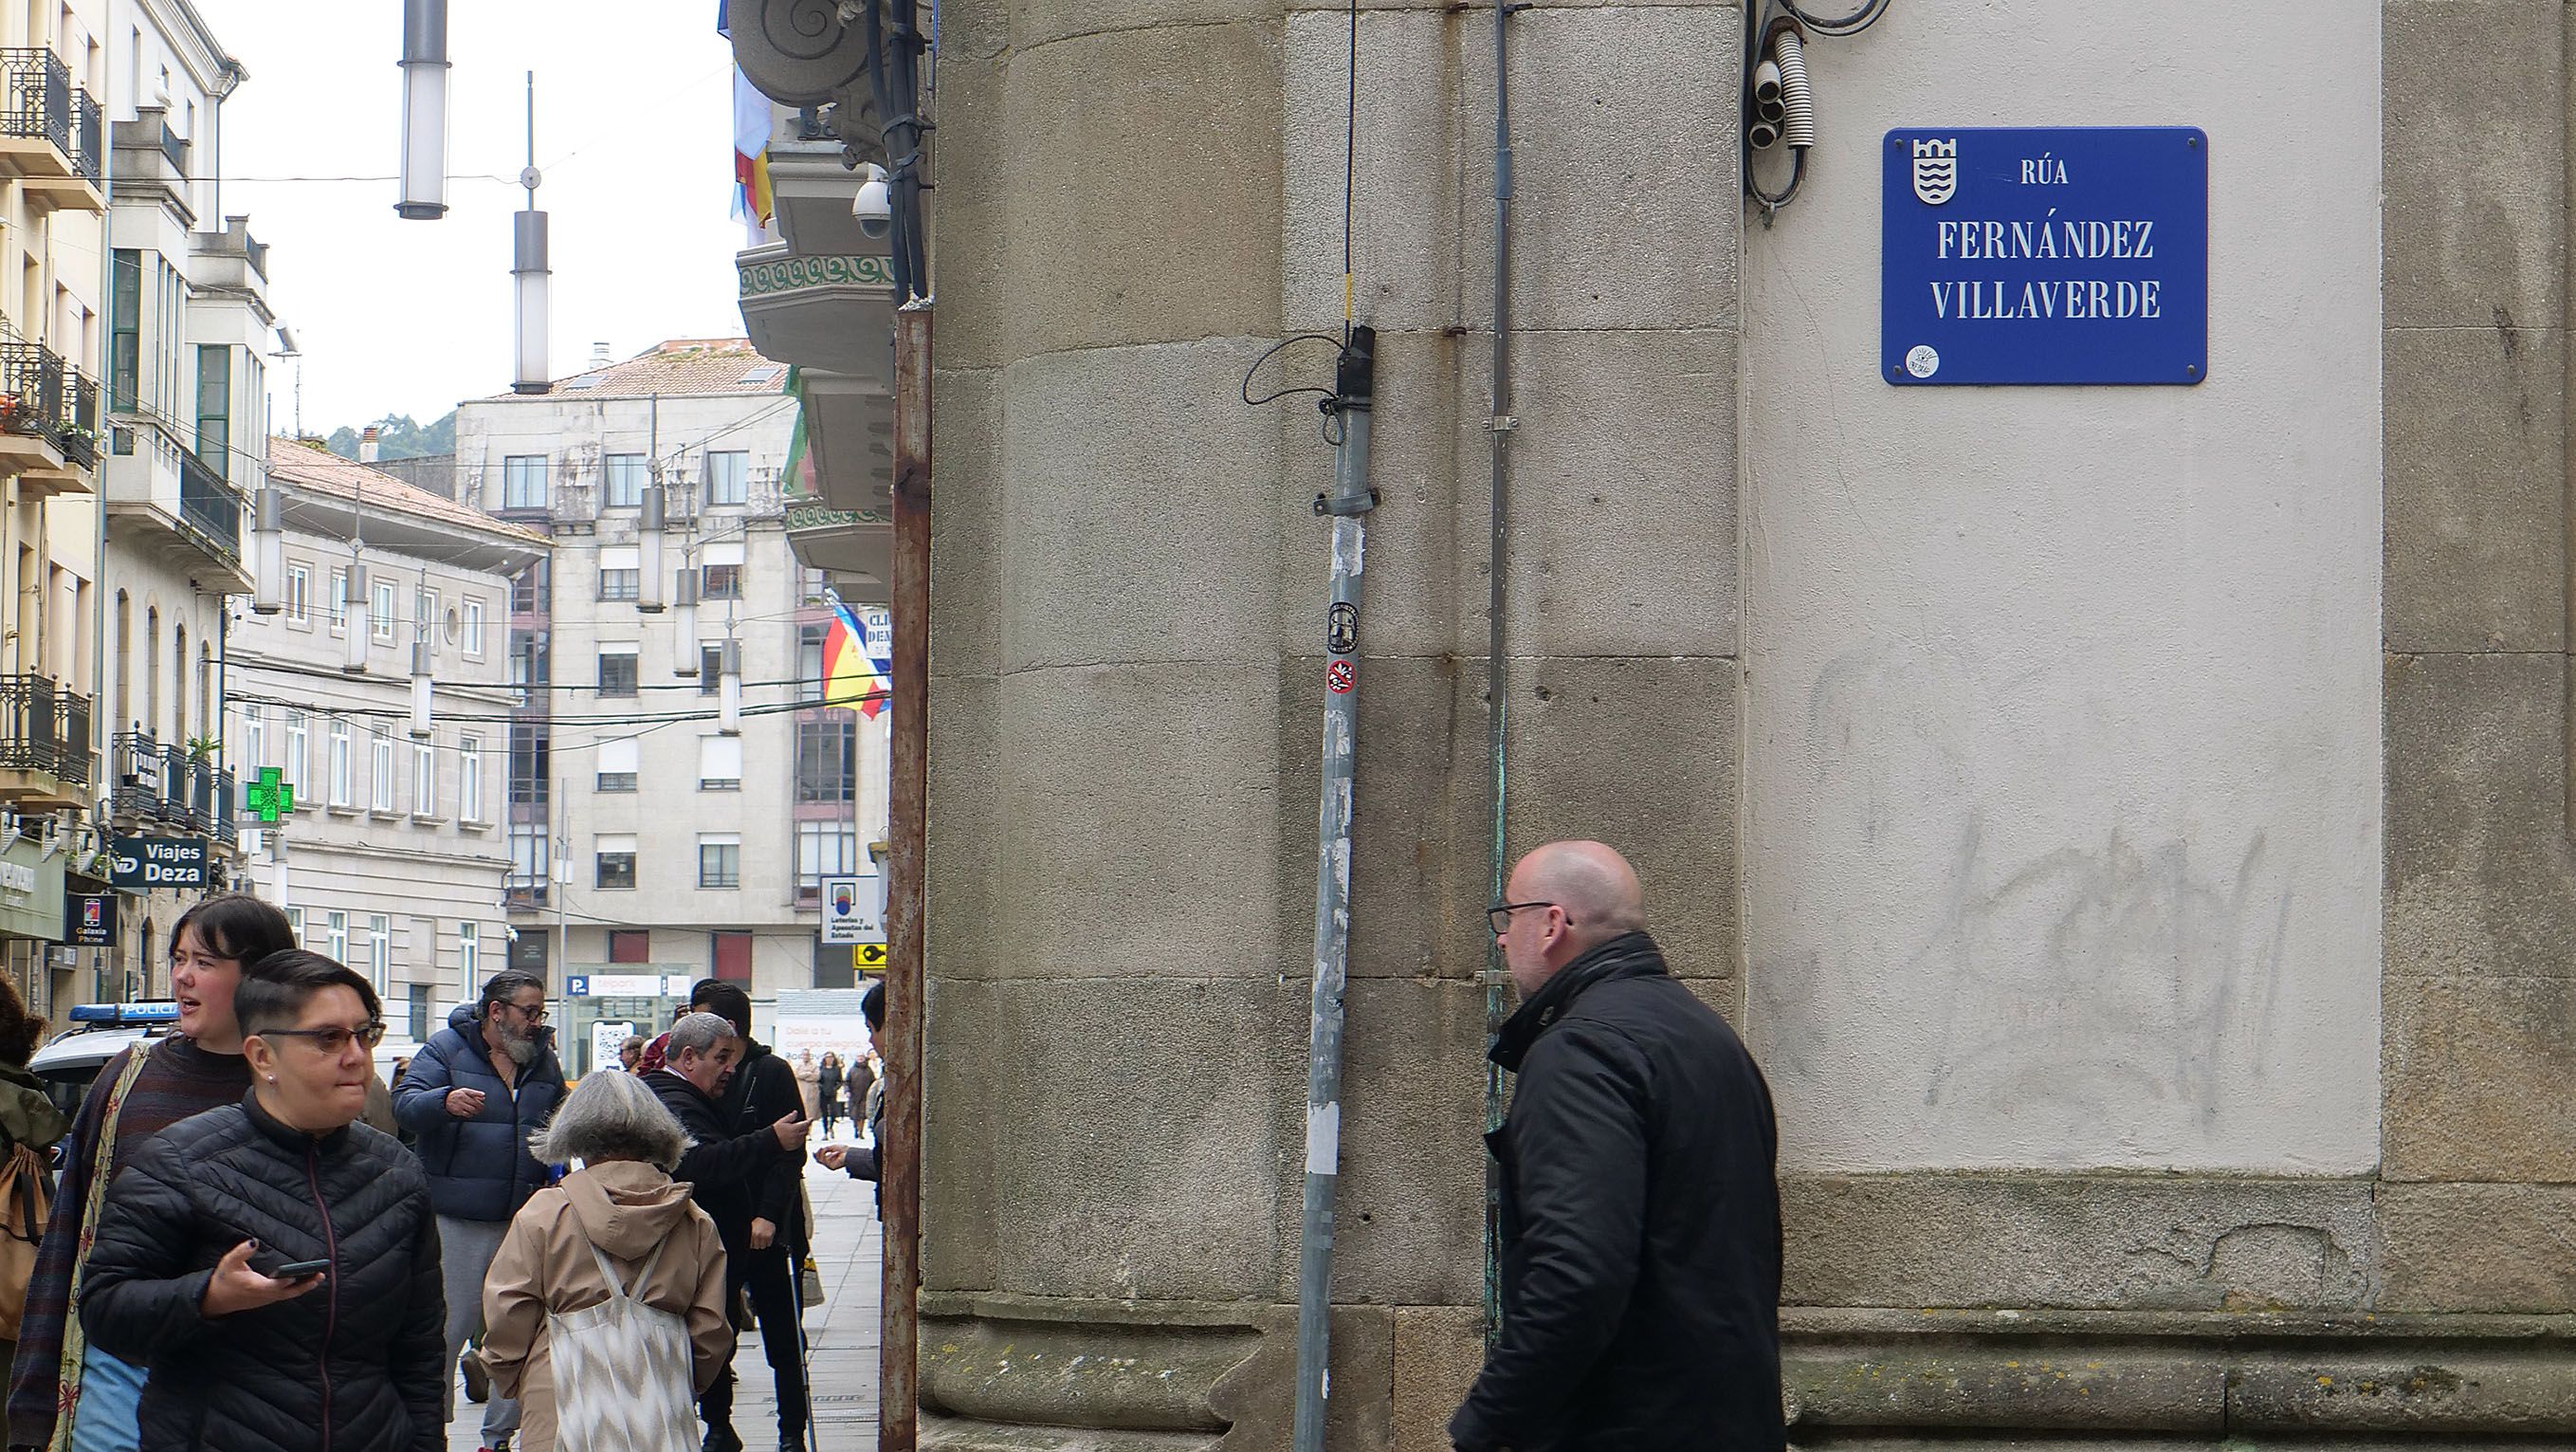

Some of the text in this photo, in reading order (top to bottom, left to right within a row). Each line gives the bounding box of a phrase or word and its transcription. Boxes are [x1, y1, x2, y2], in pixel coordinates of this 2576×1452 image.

[2020, 152, 2069, 184] RÚA
[1937, 208, 2154, 259] FERNÁNDEZ
[1930, 281, 2161, 319] VILLAVERDE
[146, 844, 201, 862] Viajes
[145, 863, 201, 882] Deza
[76, 927, 107, 935] Galaxia
[572, 979, 584, 993] P
